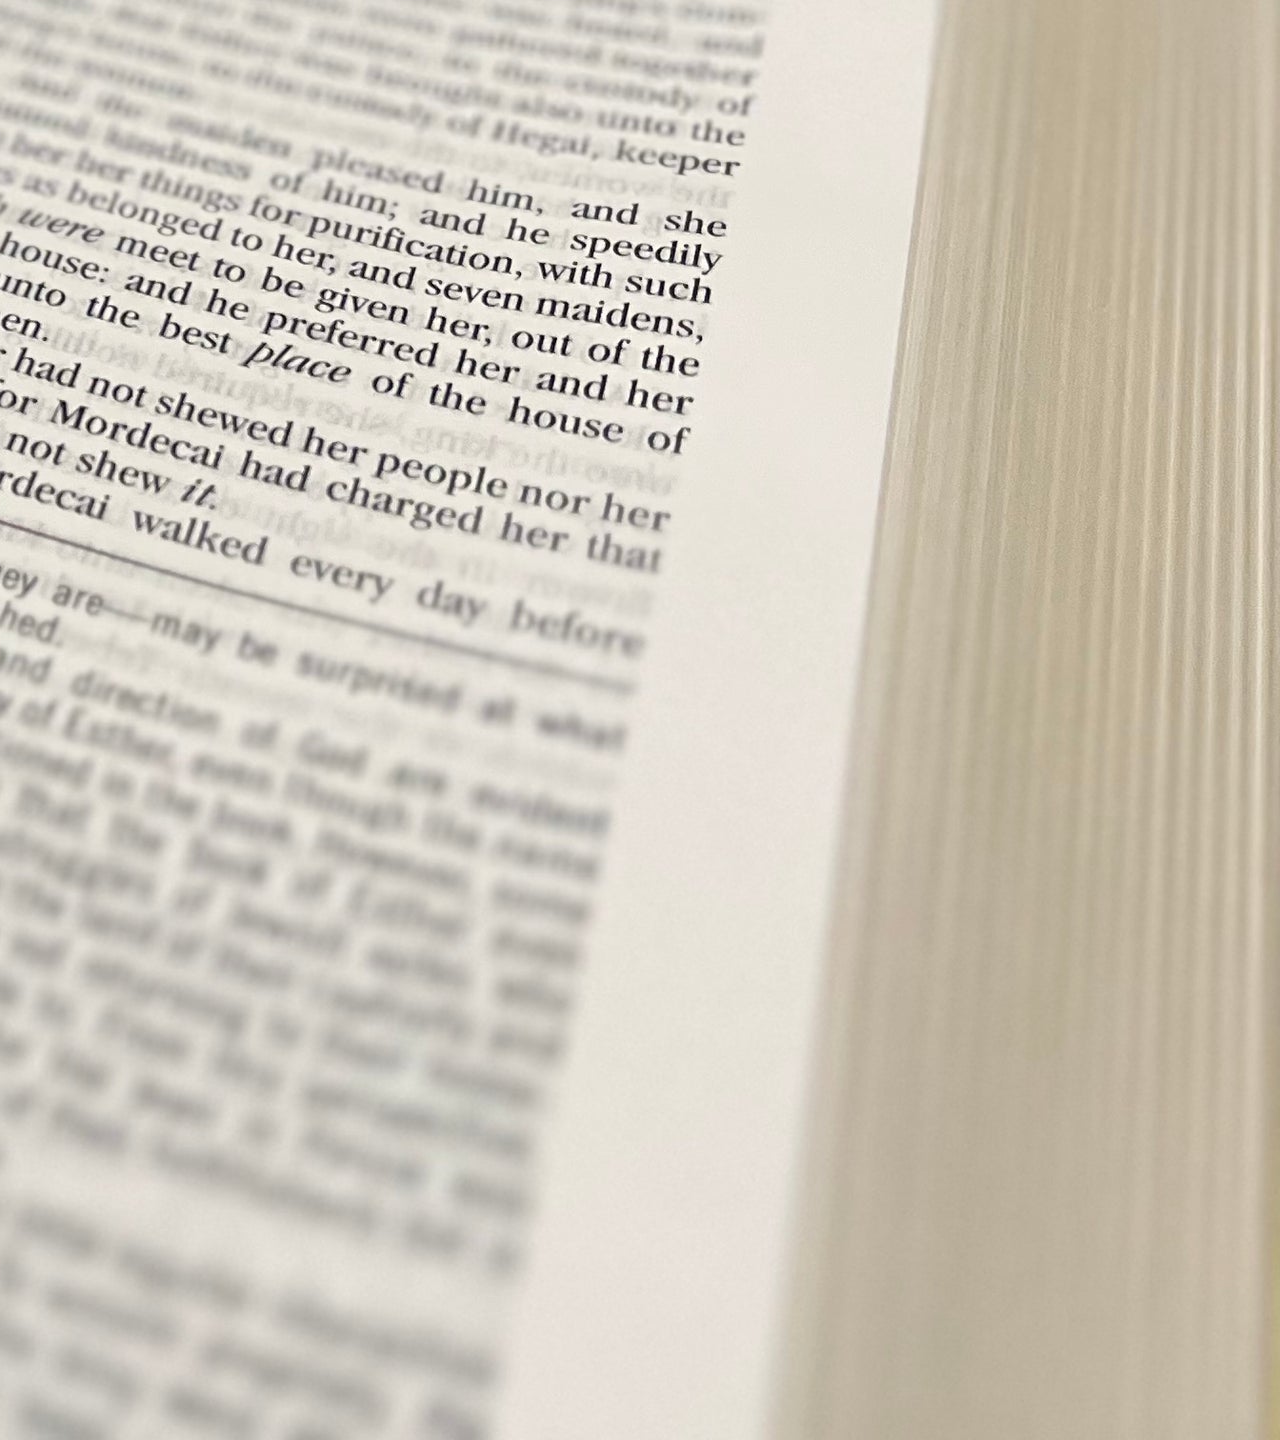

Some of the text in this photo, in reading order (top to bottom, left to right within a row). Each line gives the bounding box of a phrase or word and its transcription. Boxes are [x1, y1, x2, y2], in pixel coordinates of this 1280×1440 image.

[692, 121, 745, 146] the
[306, 216, 712, 305] purification, with such
[419, 209, 723, 276] and he speedily
[570, 202, 727, 238] and she
[114, 235, 700, 377] meet to be given her, out of the
[230, 227, 704, 345] to her, and seven maidens,
[85, 295, 141, 329] the
[158, 312, 232, 355] best
[239, 341, 353, 383] place
[371, 372, 415, 399] of
[429, 382, 487, 416] the
[507, 395, 624, 443] house
[647, 426, 692, 455] of
[123, 274, 193, 306] and
[205, 287, 250, 321] he
[261, 311, 440, 368] preferred
[454, 348, 521, 384] her
[535, 372, 609, 402] and
[625, 378, 695, 416] her
[11, 346, 82, 389] had
[86, 376, 148, 409] not
[154, 392, 294, 448] shewed
[301, 426, 369, 465] her
[373, 452, 508, 498] people
[49, 399, 225, 471] Mordecai
[239, 449, 312, 493] had
[5, 432, 66, 467] not
[74, 449, 171, 494] shew
[180, 478, 216, 510] it.
[134, 510, 269, 565] walked
